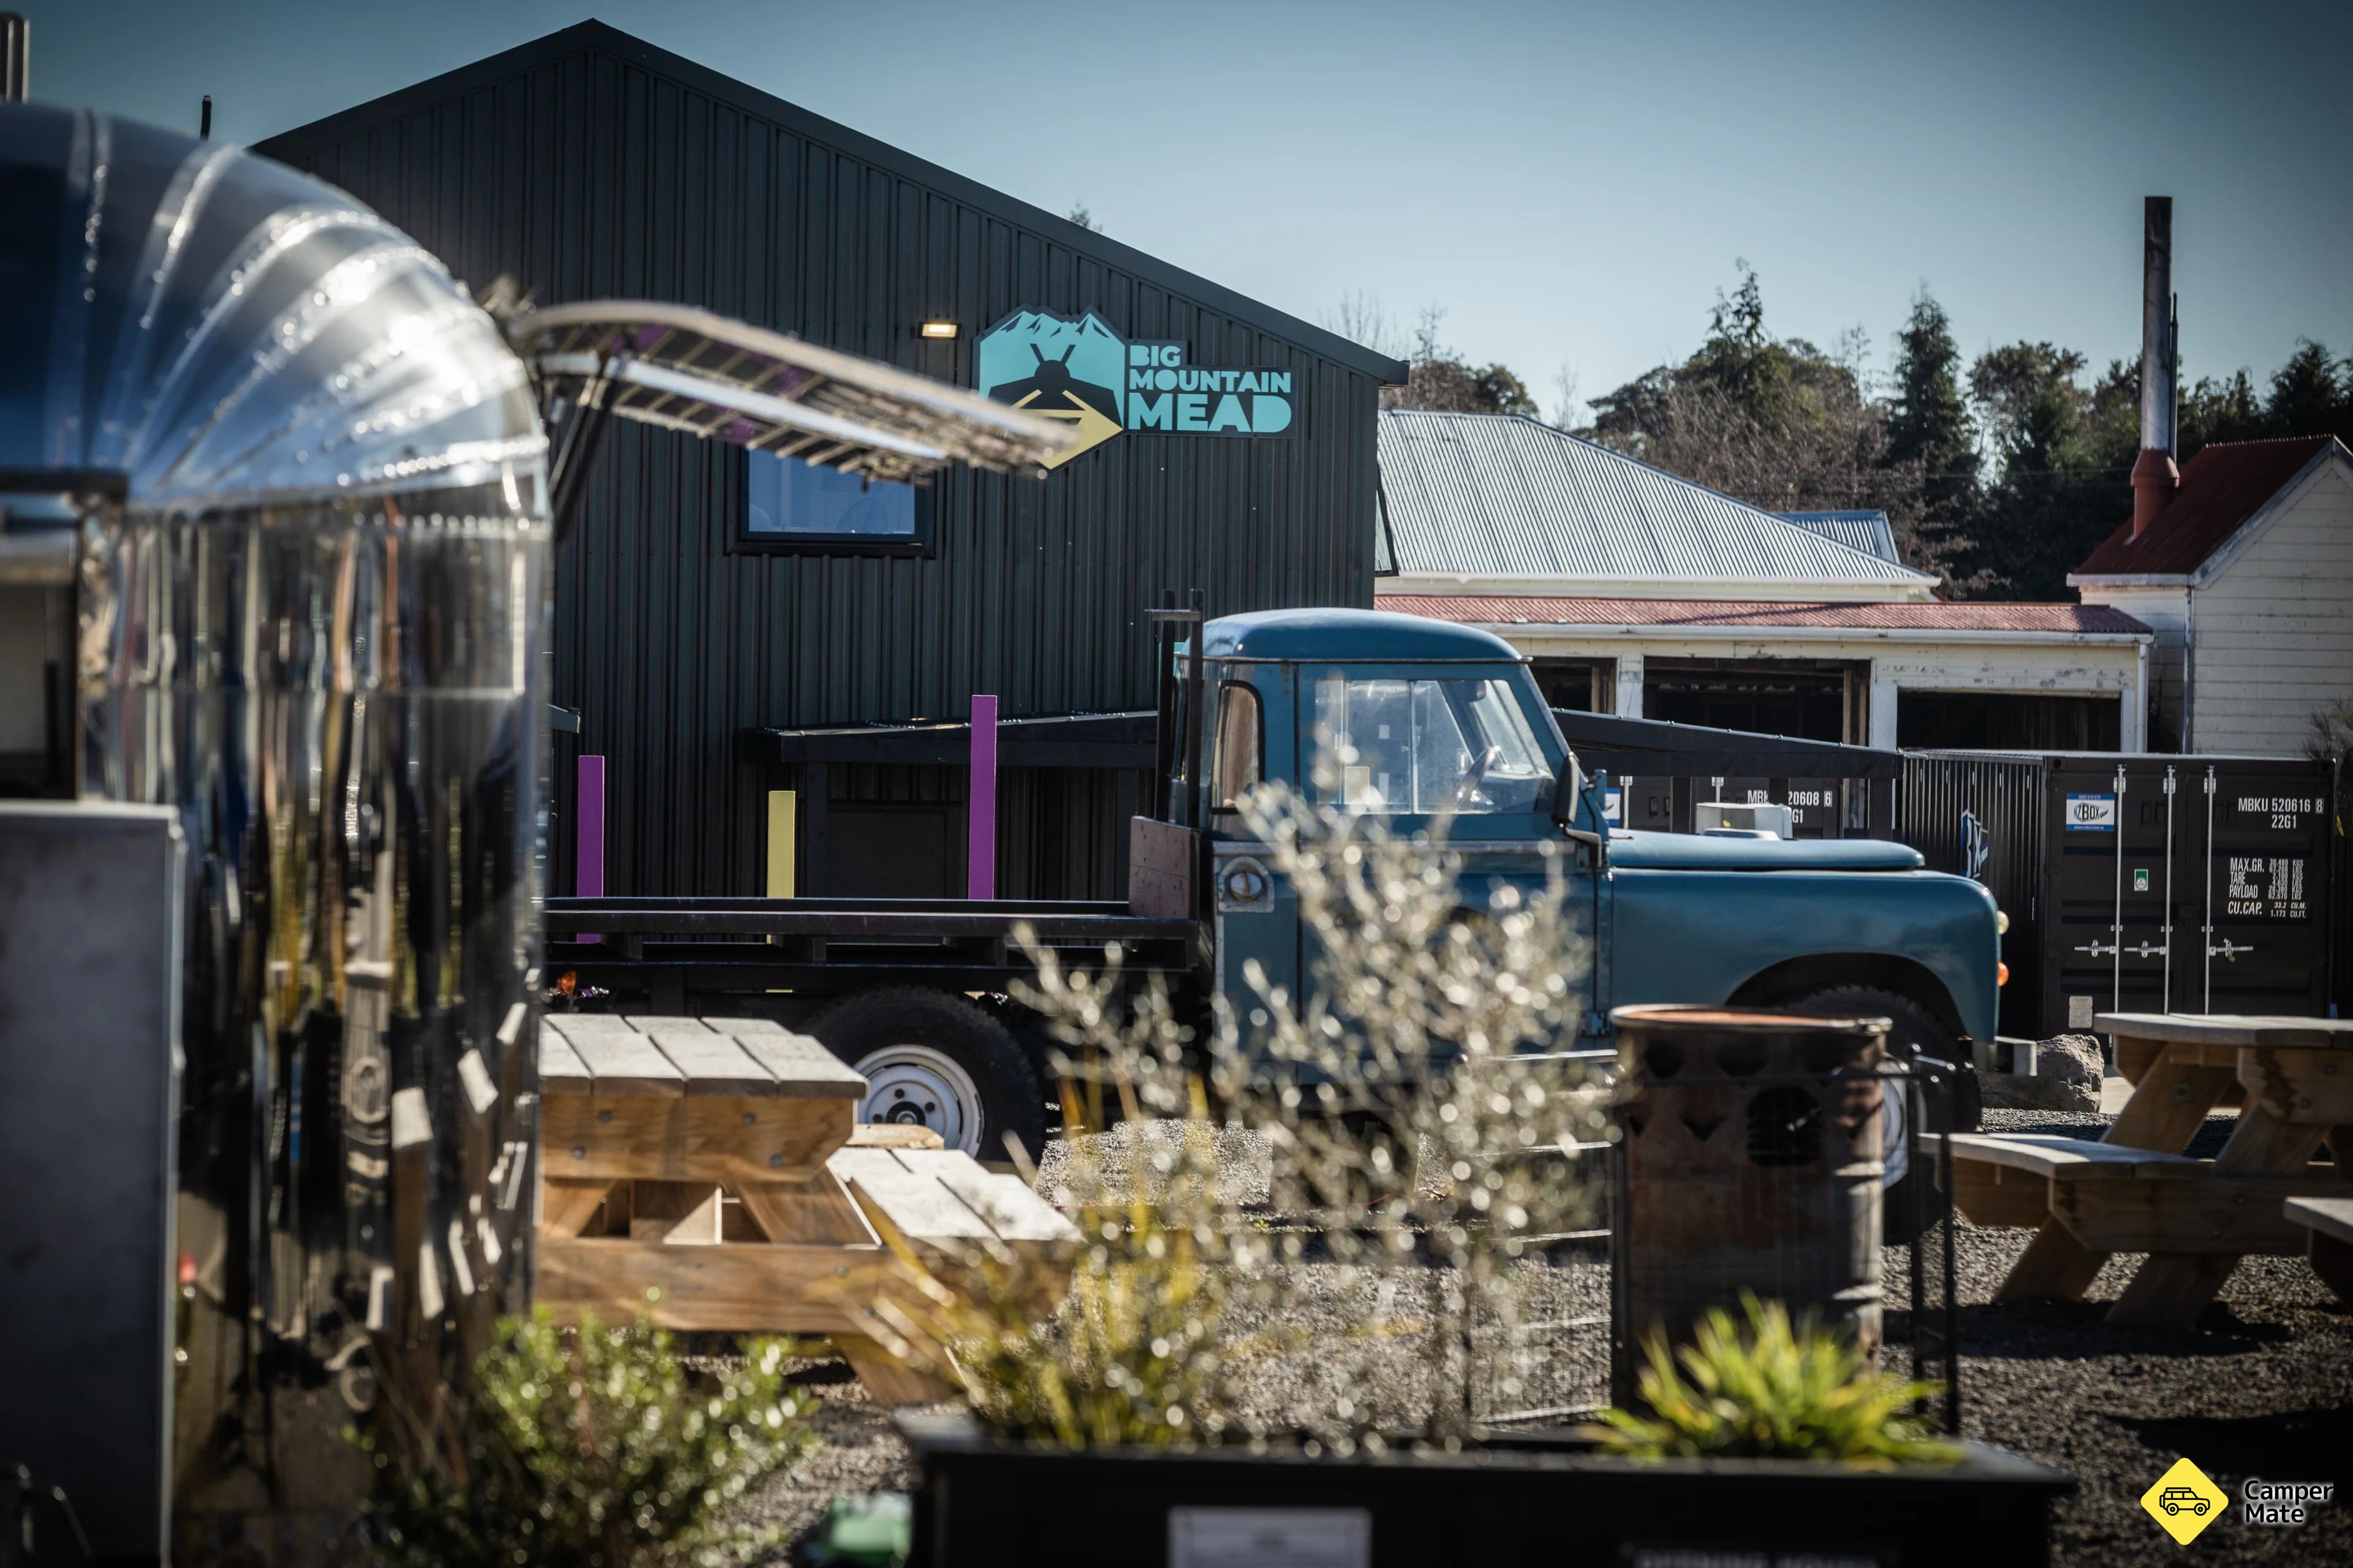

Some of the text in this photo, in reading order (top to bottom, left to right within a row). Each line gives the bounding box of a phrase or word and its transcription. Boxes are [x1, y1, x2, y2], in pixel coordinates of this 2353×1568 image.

[1130, 345, 1181, 368] BIG
[1129, 369, 1291, 393] MOUNTAIN
[1128, 392, 1292, 433] MEAD
[1789, 791, 1820, 806] 20608
[1824, 792, 1832, 807] 6
[2238, 797, 2323, 813] MBKU 520616 8
[2272, 814, 2297, 829] 22G1
[2230, 857, 2265, 873] MAX.GR.
[2230, 871, 2246, 885] TARE
[2229, 884, 2258, 899] PAYLOAD
[2228, 901, 2262, 915] CU.CAP.
